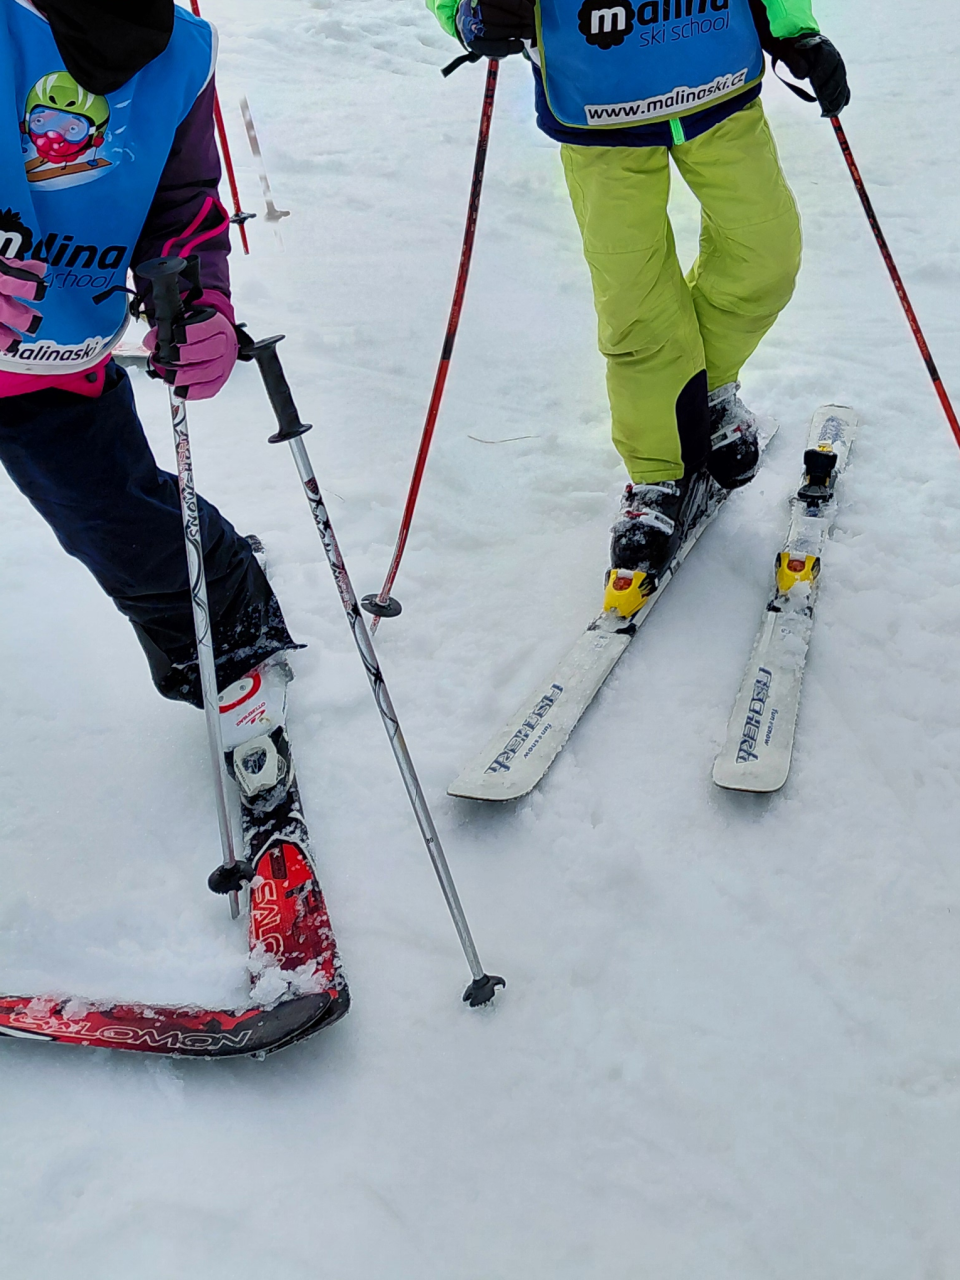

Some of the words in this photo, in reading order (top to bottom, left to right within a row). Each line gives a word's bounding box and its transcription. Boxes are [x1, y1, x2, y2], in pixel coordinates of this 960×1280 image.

[639, 23, 666, 47] ski
[671, 11, 730, 42] school
[587, 71, 745, 120] www.malinaski.cz
